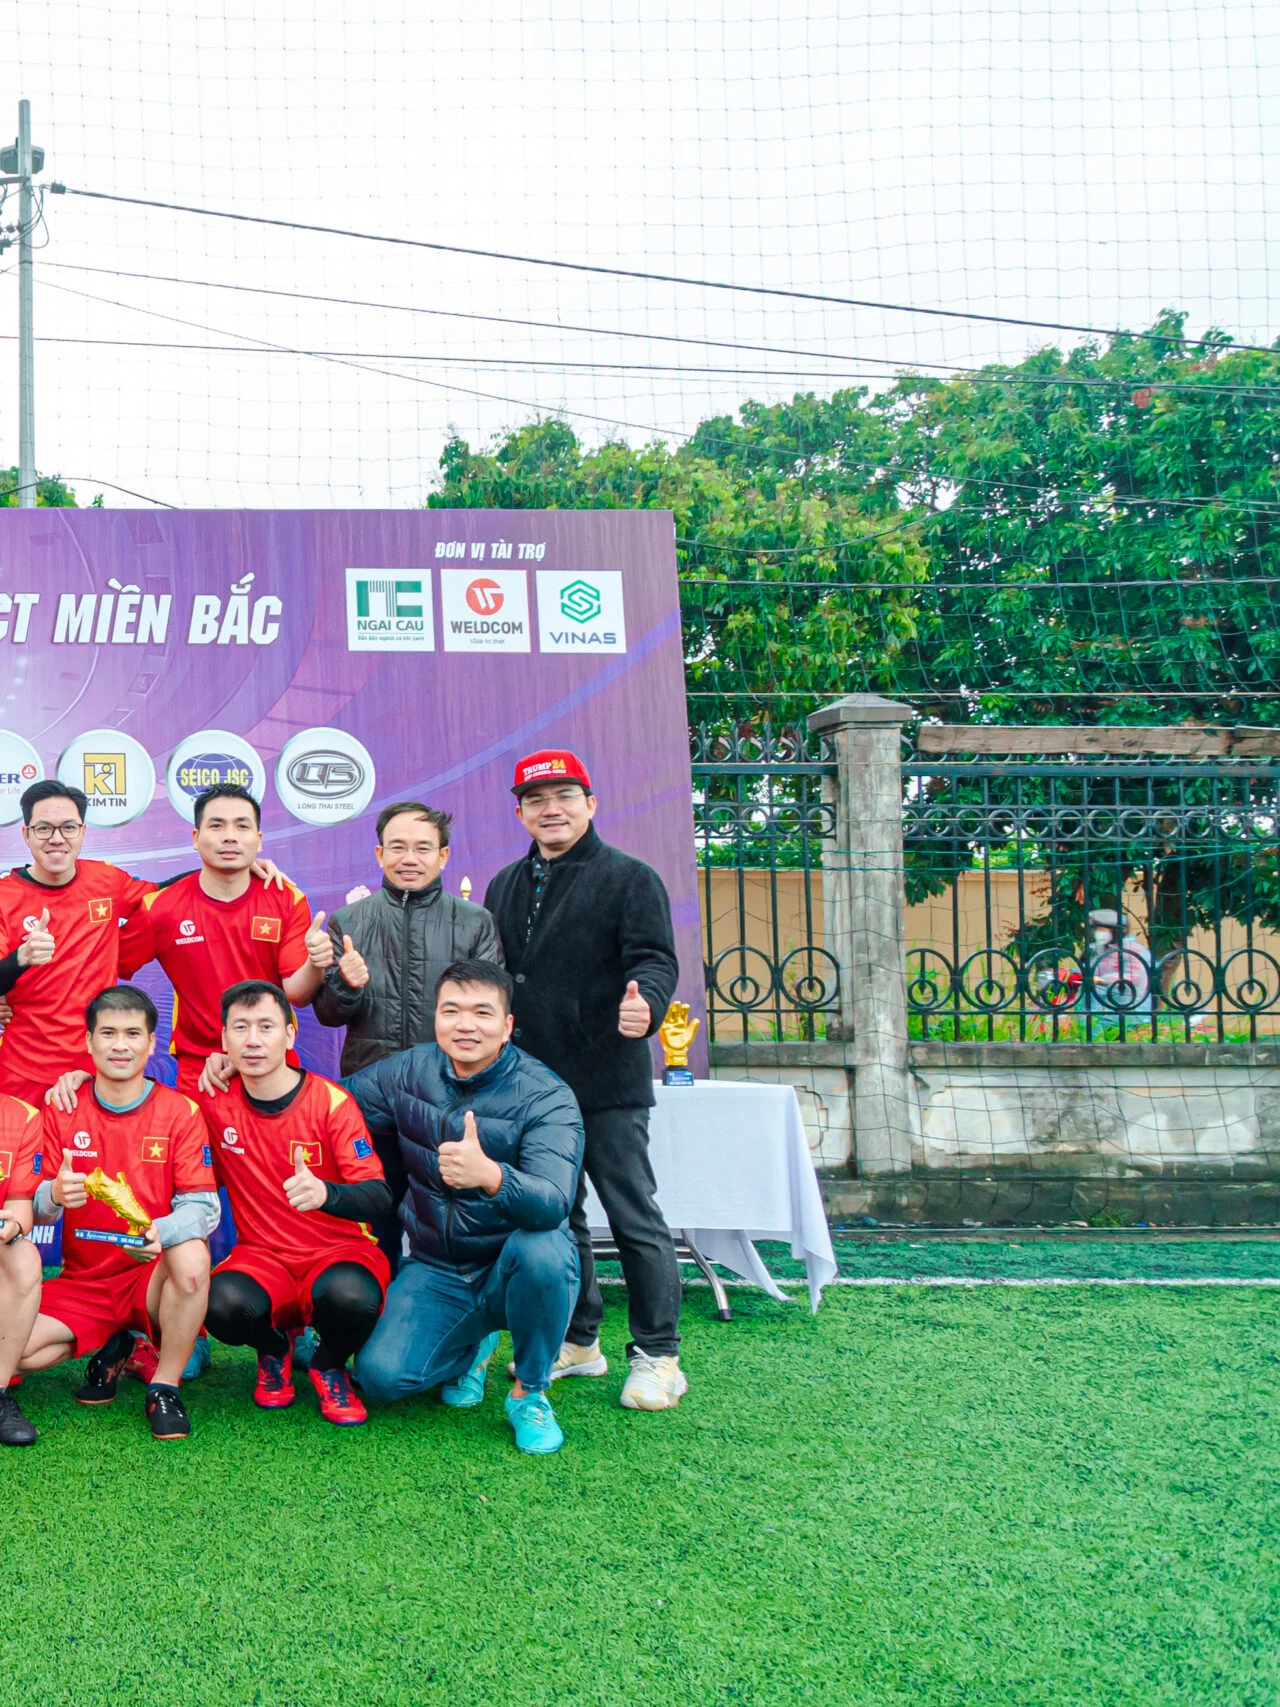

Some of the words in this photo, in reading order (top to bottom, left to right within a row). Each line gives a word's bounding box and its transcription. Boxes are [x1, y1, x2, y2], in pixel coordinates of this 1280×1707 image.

[435, 541, 466, 559] ĐƠN
[471, 542, 486, 561] VỊ
[491, 539, 513, 559] TÀI
[518, 541, 547, 562] TRỢ
[52, 577, 173, 645] MIỀN
[187, 572, 284, 646] BẮC
[357, 620, 391, 631] NGAI
[396, 620, 424, 631] CAU
[451, 621, 523, 634] WELDCOM
[549, 631, 617, 644] VINAS
[523, 762, 552, 775] TRUMP
[180, 767, 220, 786] SEICO
[223, 767, 249, 787] JSC
[108, 797, 127, 807] TIN
[297, 802, 317, 810] LONG
[335, 802, 355, 810] STEEL
